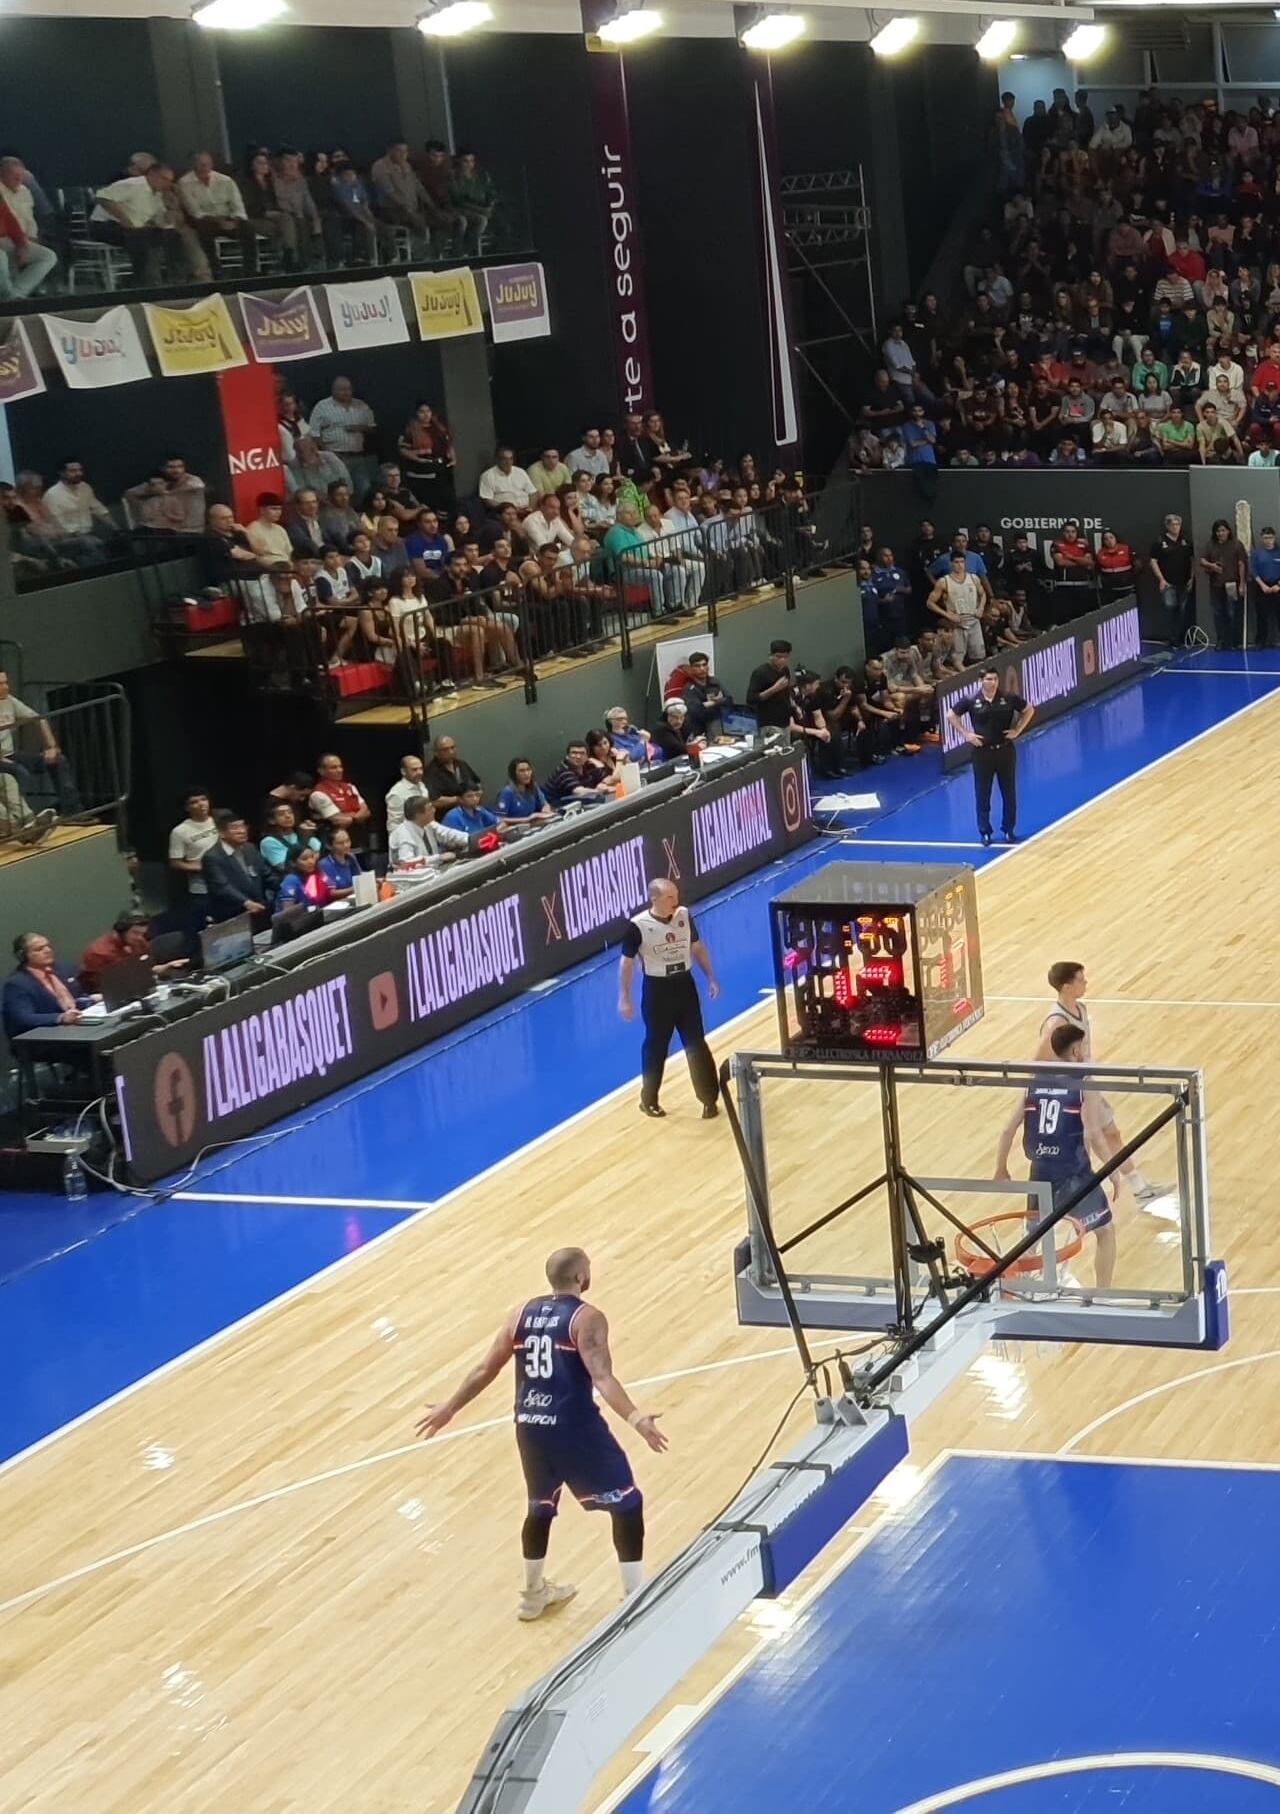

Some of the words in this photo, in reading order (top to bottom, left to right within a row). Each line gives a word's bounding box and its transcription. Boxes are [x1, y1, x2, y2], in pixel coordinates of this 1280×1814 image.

[601, 145, 633, 297] seguir
[620, 311, 638, 343] a
[560, 834, 649, 941] /LIGABASQUET
[406, 893, 525, 1022] /LALIGABASQUET
[202, 974, 354, 1122] /LALIGABASQUET
[1038, 1098, 1061, 1135] 19
[524, 1335, 554, 1379] 33
